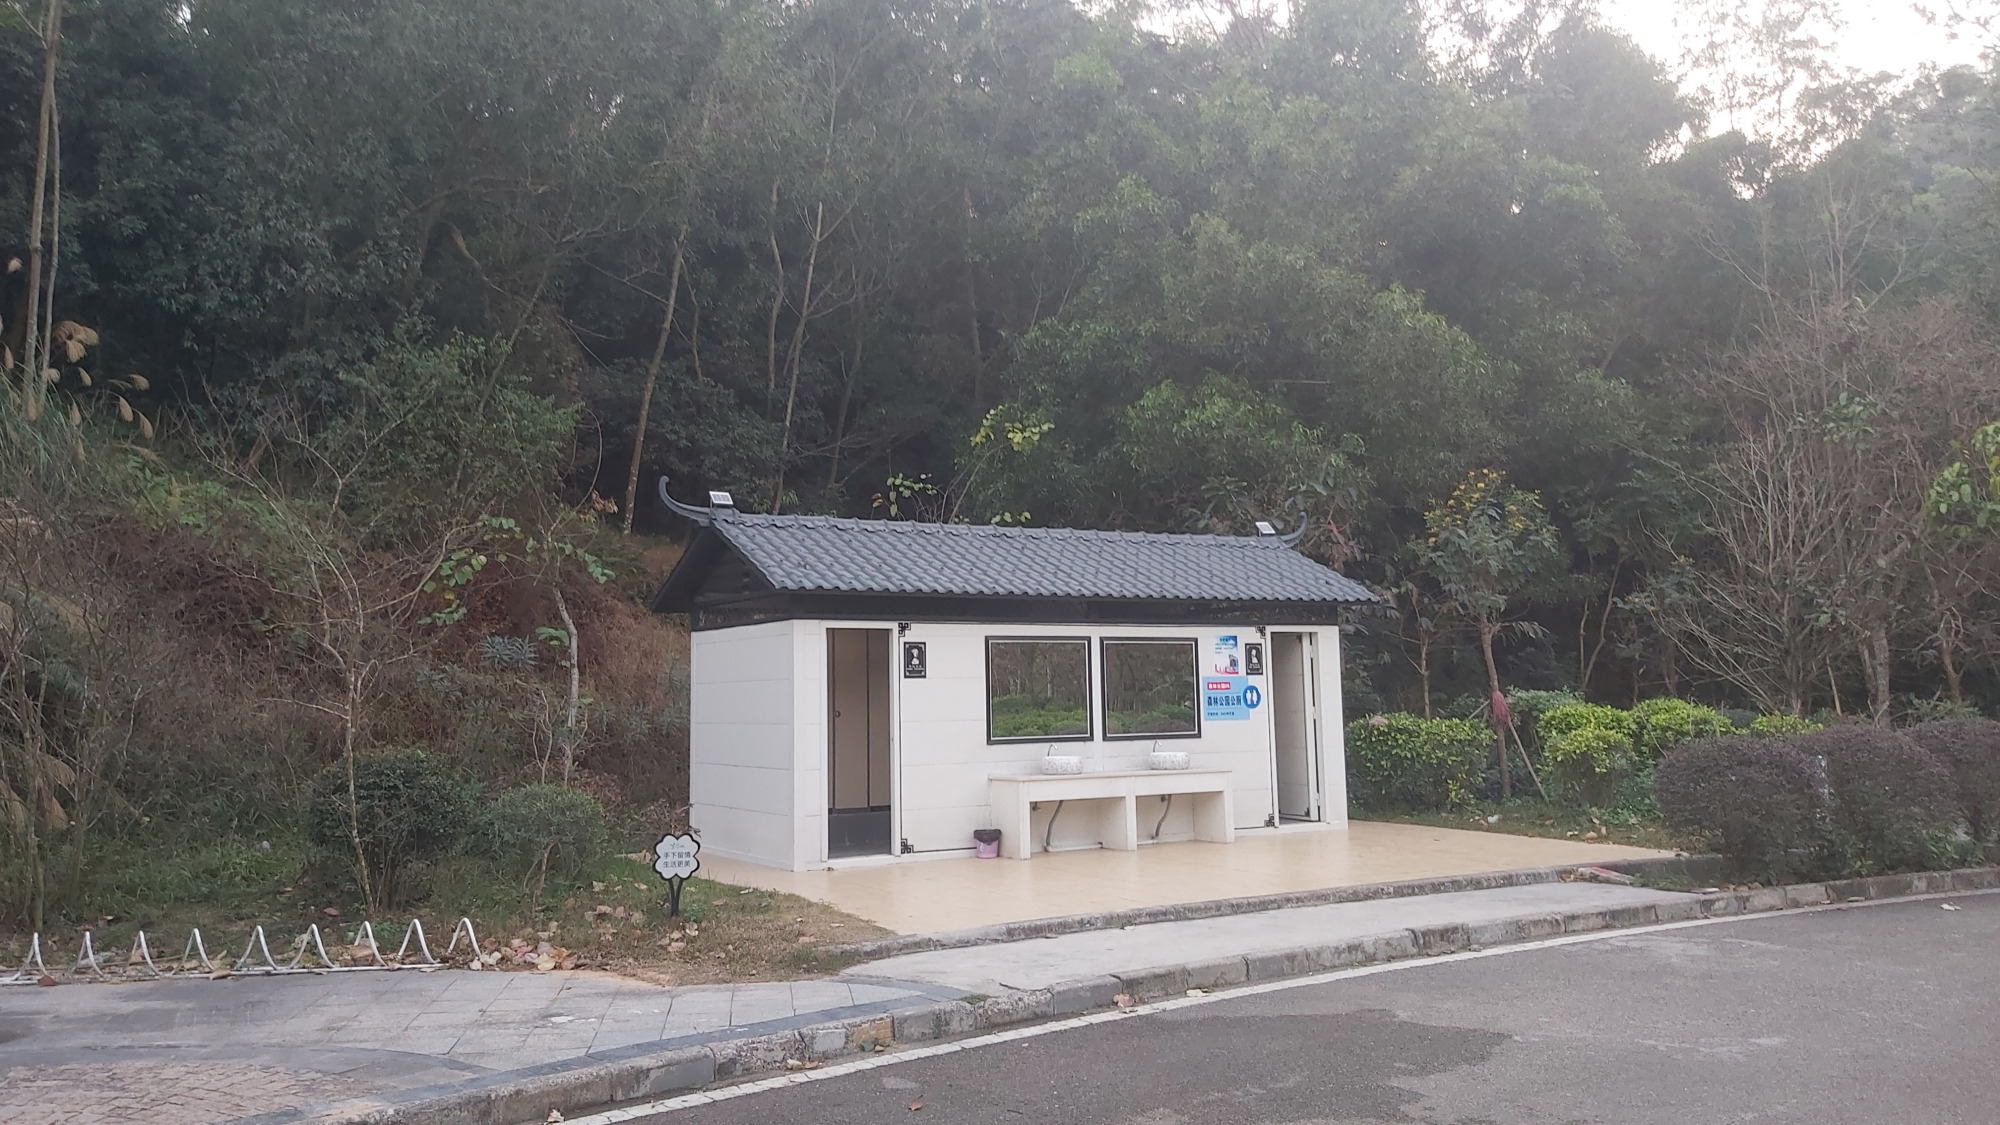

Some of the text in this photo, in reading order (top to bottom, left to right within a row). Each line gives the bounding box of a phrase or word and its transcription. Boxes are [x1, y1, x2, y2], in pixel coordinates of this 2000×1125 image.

[663, 851, 691, 859] 手下留情
[663, 860, 691, 868] 生活更美
